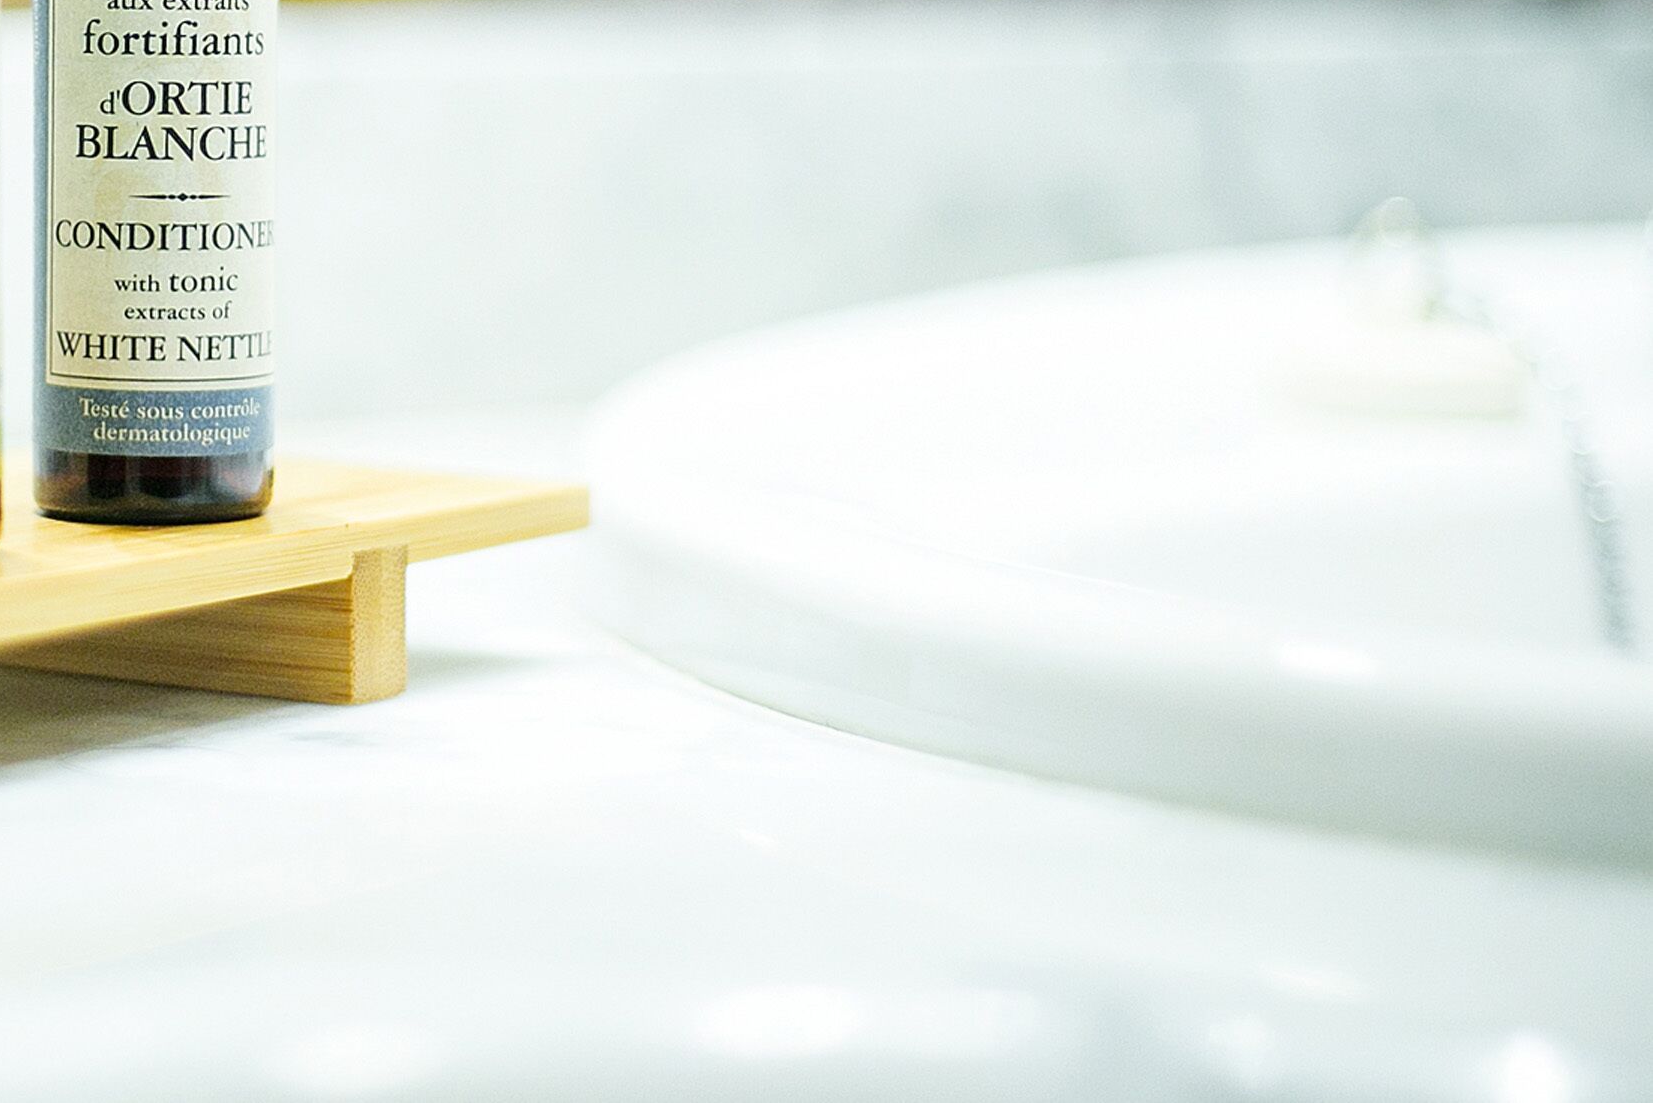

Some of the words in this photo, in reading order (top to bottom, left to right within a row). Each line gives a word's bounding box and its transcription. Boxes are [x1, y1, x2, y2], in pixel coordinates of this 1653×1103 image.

[82, 18, 266, 57] fortifiants
[99, 81, 253, 116] d'ORTIE
[75, 124, 268, 161] BLANCHE
[55, 218, 276, 251] CONDITIONER
[114, 274, 161, 293] with
[169, 266, 239, 293] tonic
[123, 304, 206, 321] extracts
[212, 300, 233, 320] of
[56, 330, 167, 362] WHITE
[79, 397, 130, 418] Testé
[137, 406, 185, 420] sous
[191, 399, 262, 419] contrôle
[93, 422, 251, 447] dermatologique
